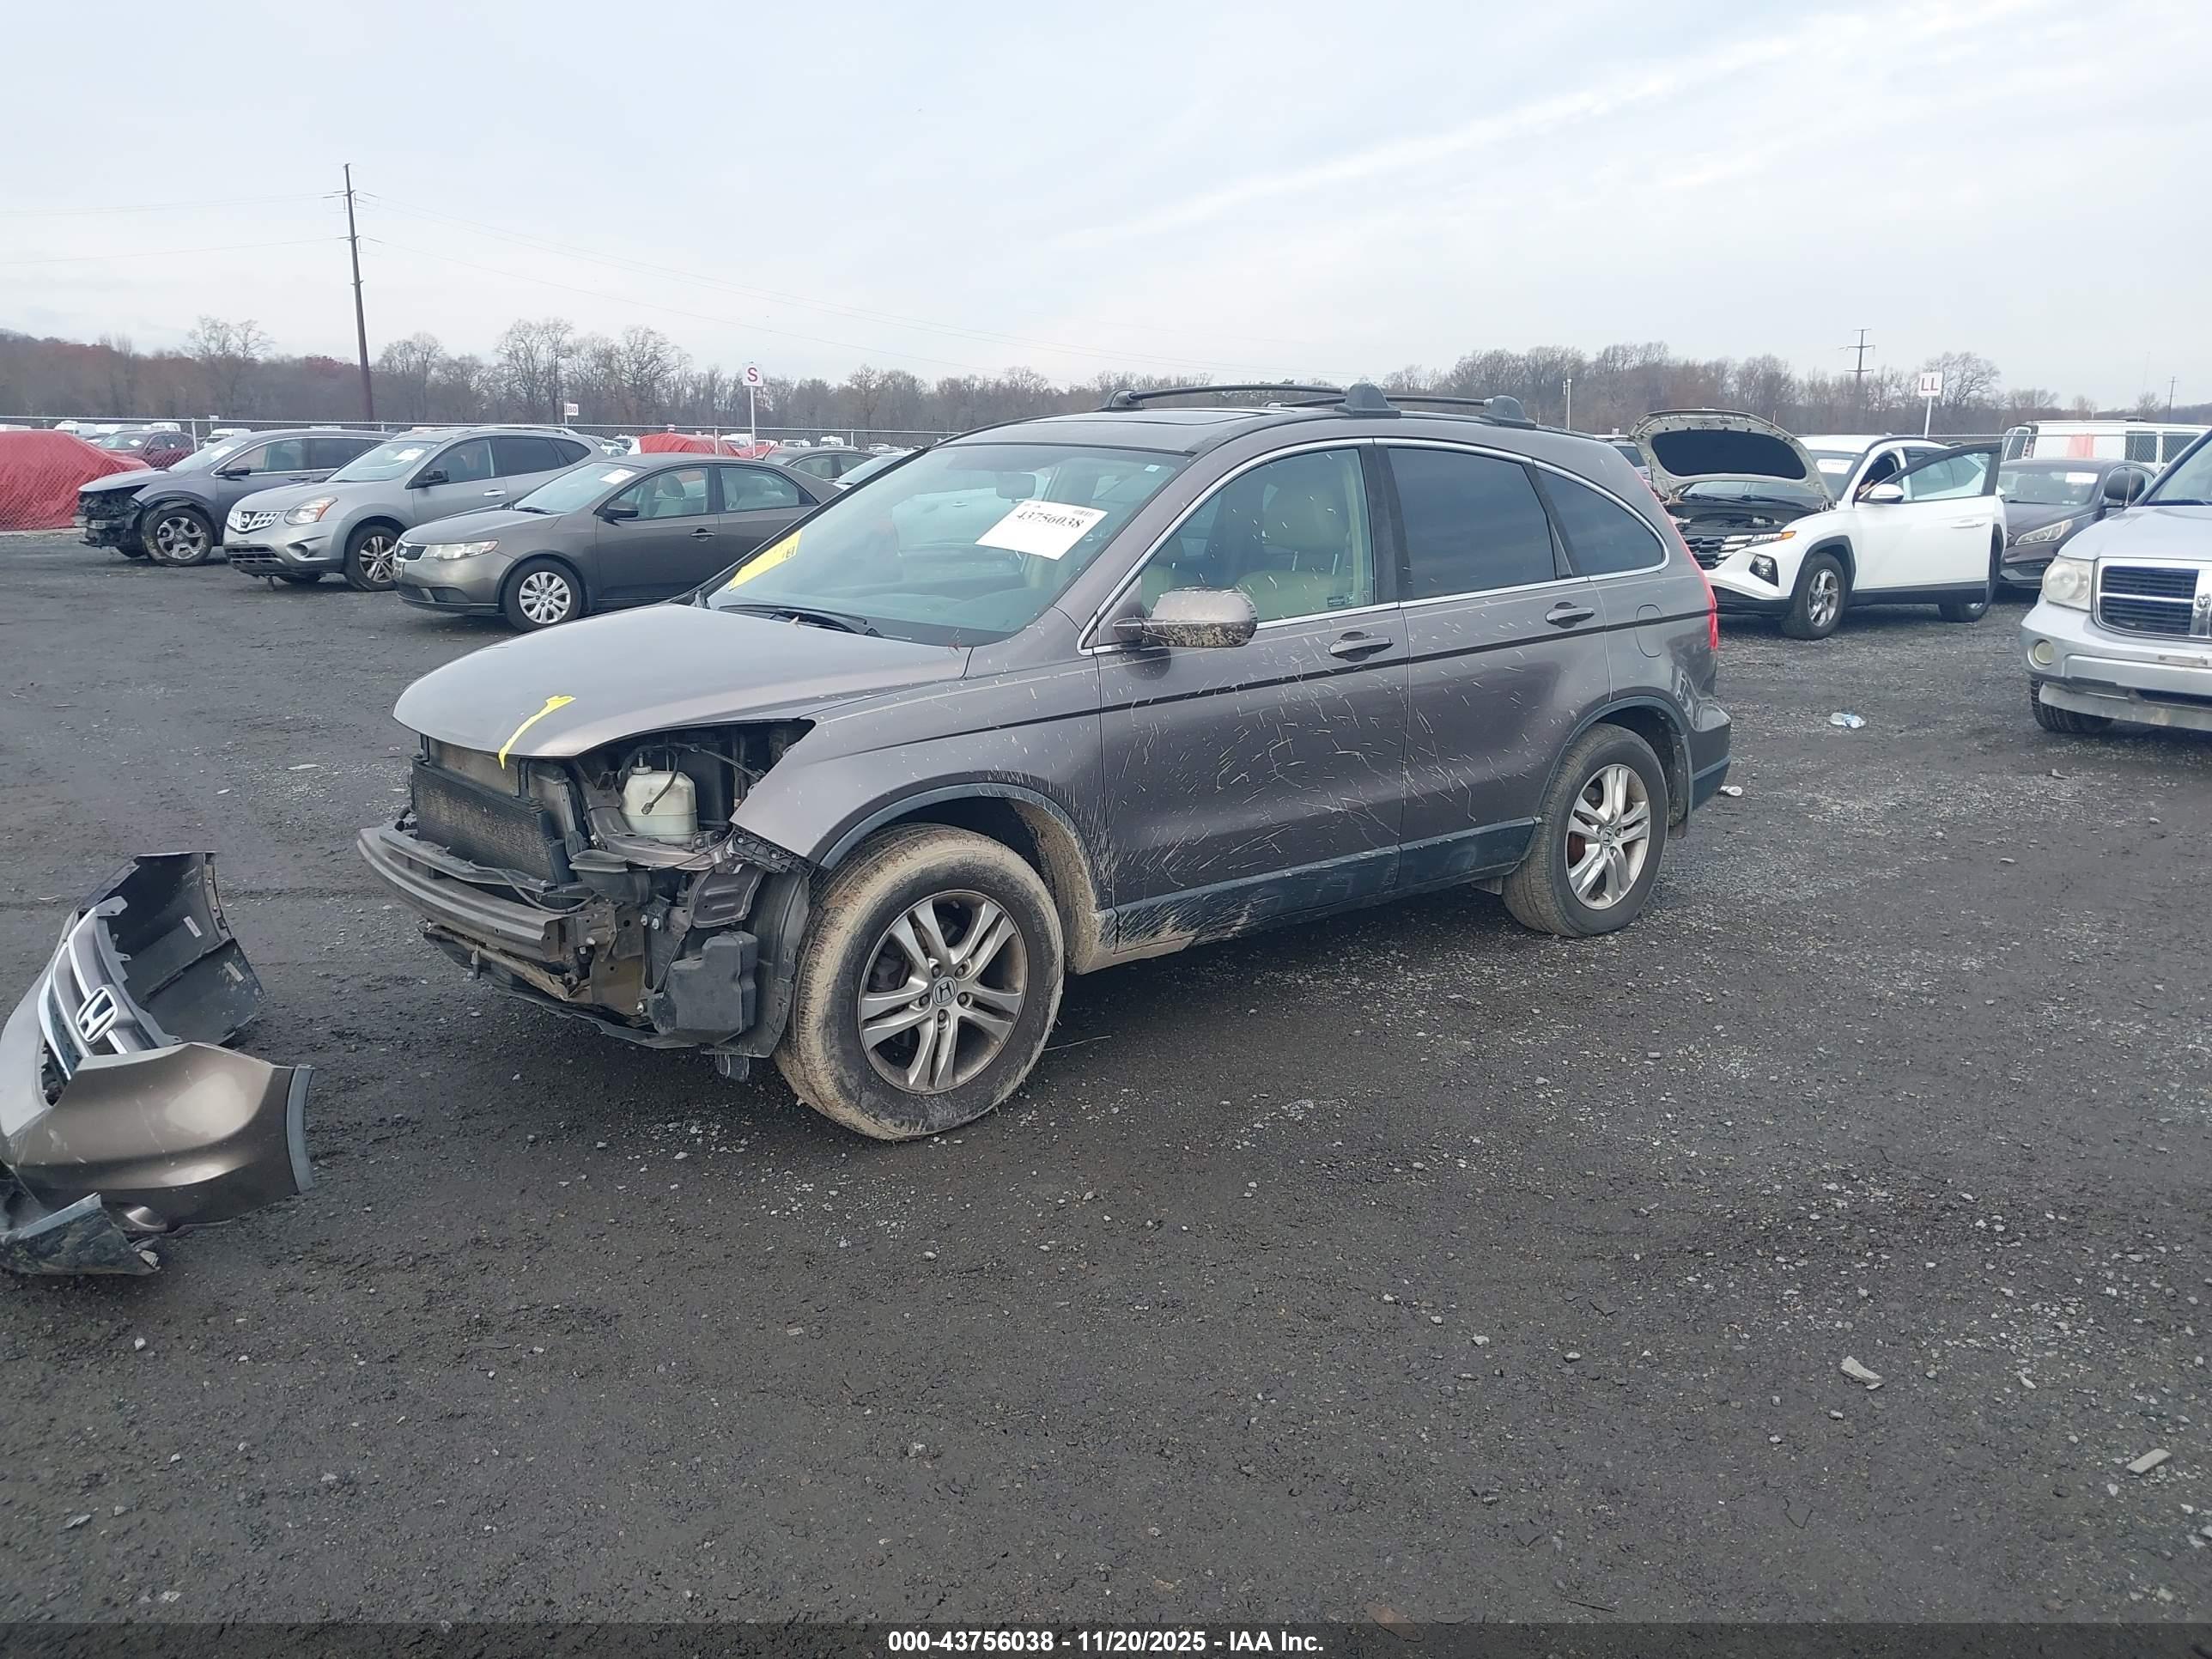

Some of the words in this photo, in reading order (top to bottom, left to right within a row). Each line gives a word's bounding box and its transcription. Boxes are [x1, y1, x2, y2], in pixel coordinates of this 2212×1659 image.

[747, 367, 758, 382] S
[1921, 377, 1939, 392] LL
[1017, 511, 1085, 528] 43756038
